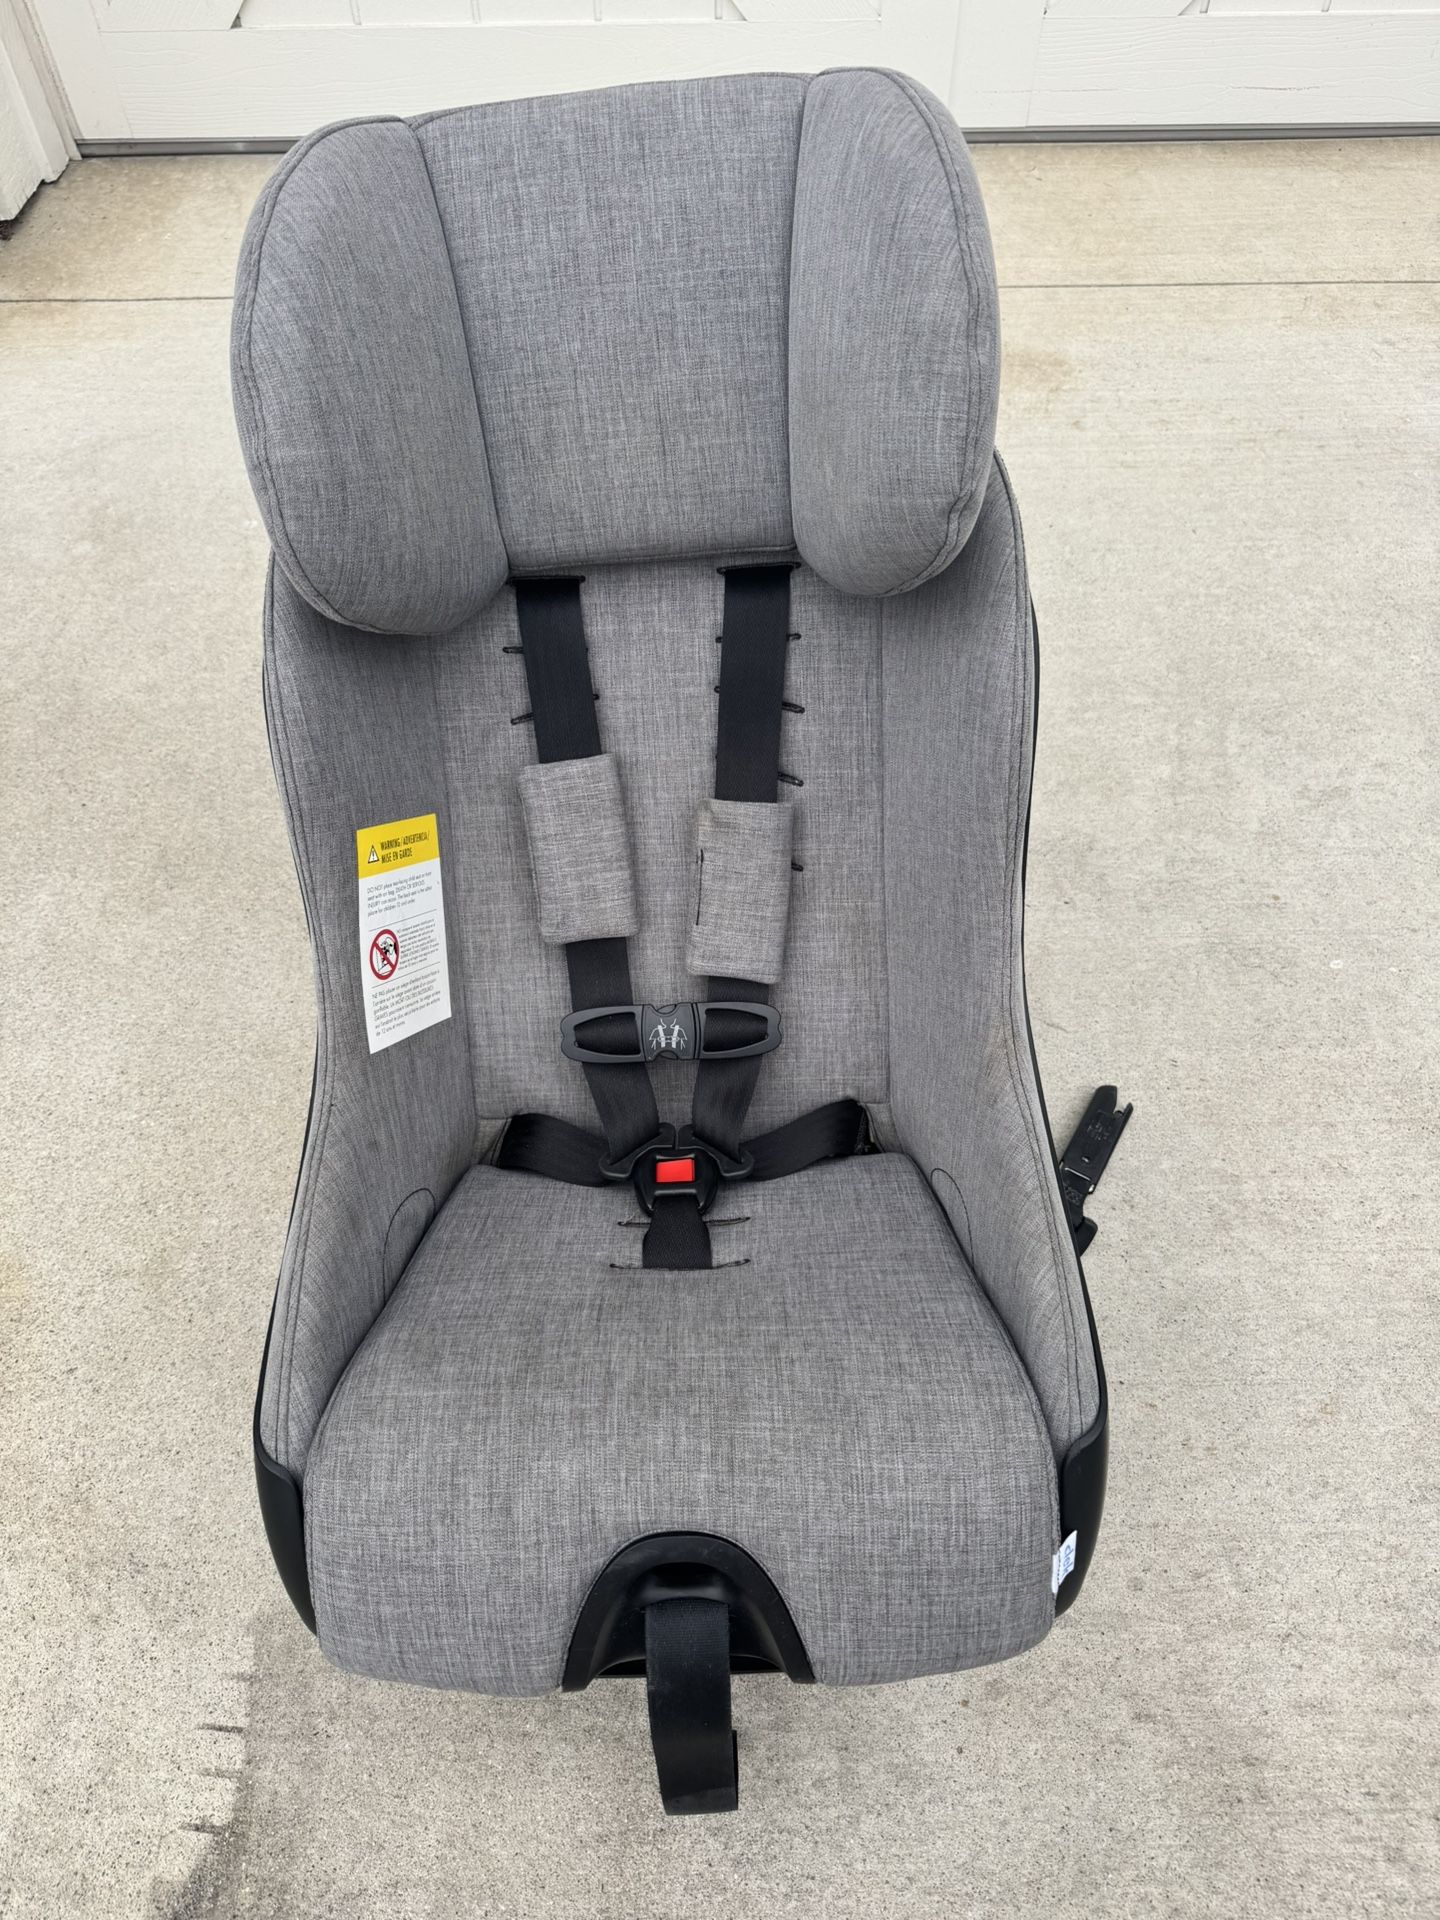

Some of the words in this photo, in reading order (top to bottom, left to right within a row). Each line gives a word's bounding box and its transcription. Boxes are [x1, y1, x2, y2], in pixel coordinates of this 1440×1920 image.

[382, 853, 392, 864] MISE
[393, 851, 398, 861] EN
[400, 848, 413, 859] GARDE
